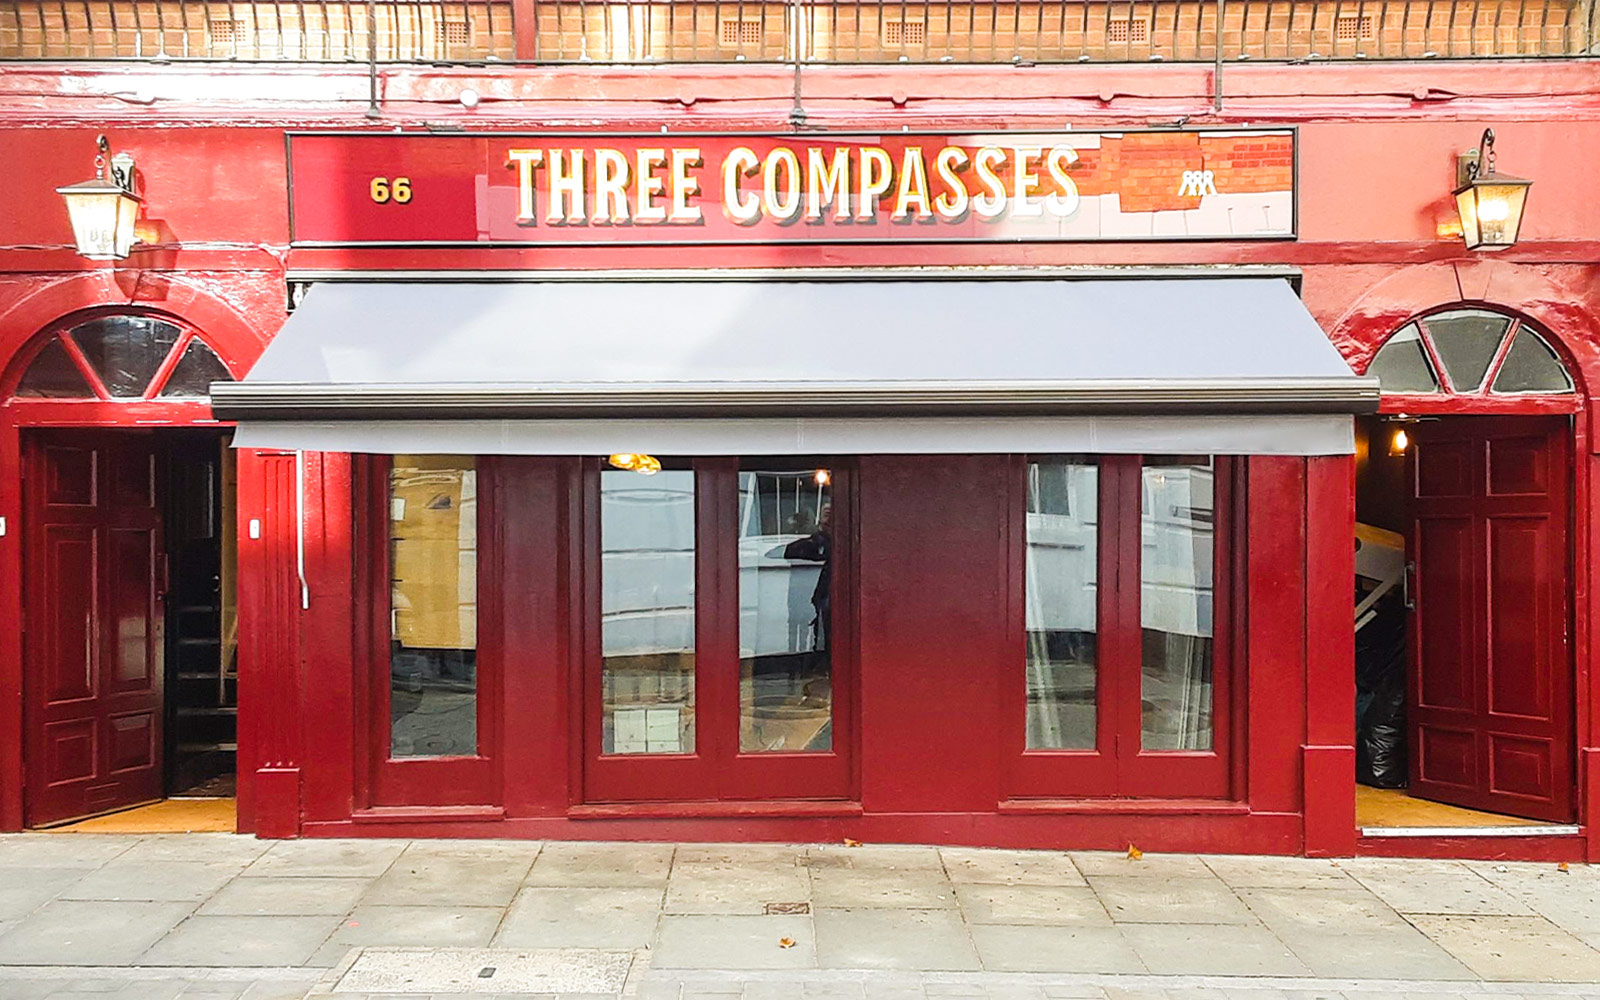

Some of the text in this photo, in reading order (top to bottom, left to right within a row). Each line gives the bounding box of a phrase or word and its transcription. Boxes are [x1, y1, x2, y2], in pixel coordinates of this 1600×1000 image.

[370, 176, 413, 205] 66
[506, 144, 1081, 226] THREE COMPASSES
